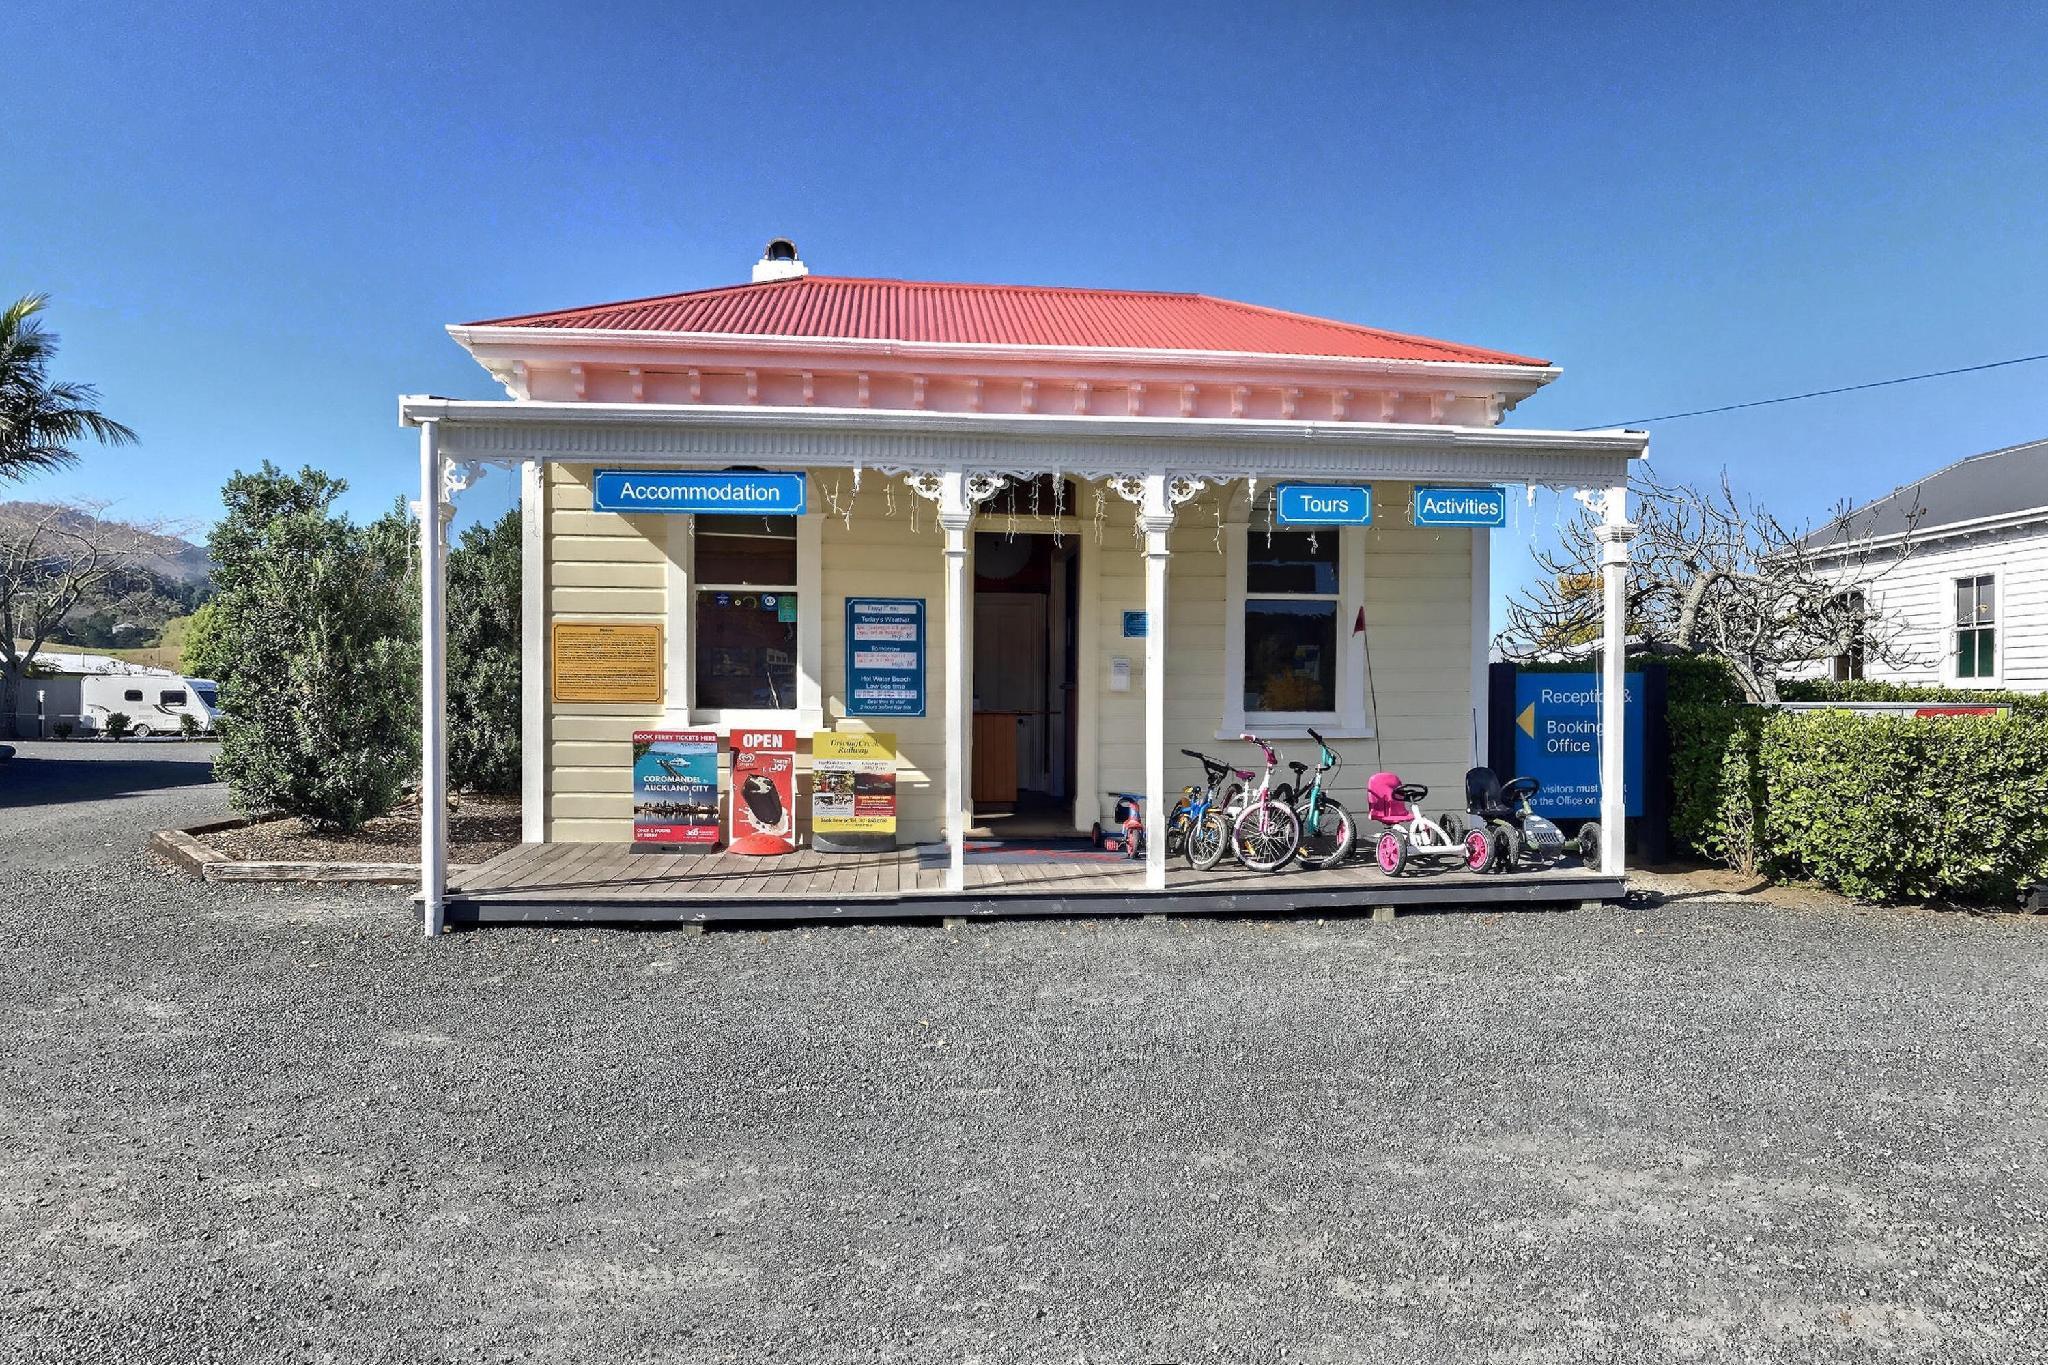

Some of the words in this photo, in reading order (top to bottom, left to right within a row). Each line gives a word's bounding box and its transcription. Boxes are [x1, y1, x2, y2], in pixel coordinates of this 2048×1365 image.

[620, 482, 780, 501] Accommodation
[1299, 495, 1349, 513] Tours
[1423, 497, 1498, 515] Activities
[1547, 720, 1604, 736] Booking
[742, 733, 783, 748] OPEN
[1547, 738, 1591, 753] Office
[771, 764, 787, 772] JOY
[643, 775, 701, 783] COROMANDEL
[643, 784, 689, 792] AUCKLAND
[1542, 784, 1574, 793] visitors
[1575, 784, 1599, 793] must
[1540, 797, 1554, 805] the
[1556, 796, 1583, 805] Office
[1584, 797, 1597, 805] on
